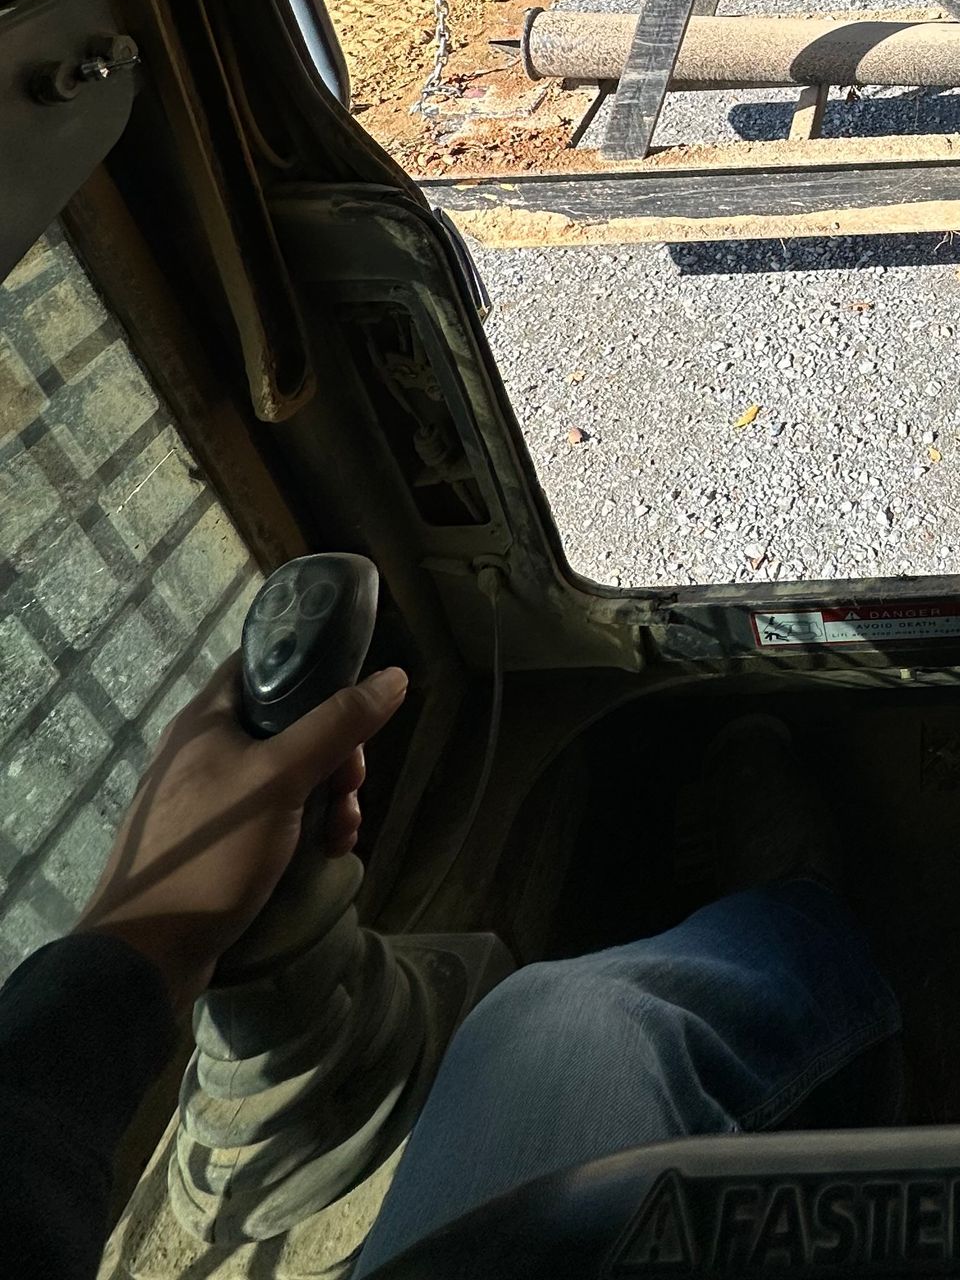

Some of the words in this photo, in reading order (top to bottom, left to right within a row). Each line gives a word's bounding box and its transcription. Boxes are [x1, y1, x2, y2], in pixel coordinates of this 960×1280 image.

[869, 607, 942, 620] DANGER
[856, 622, 893, 630] AVOID
[898, 620, 937, 629] DEATH
